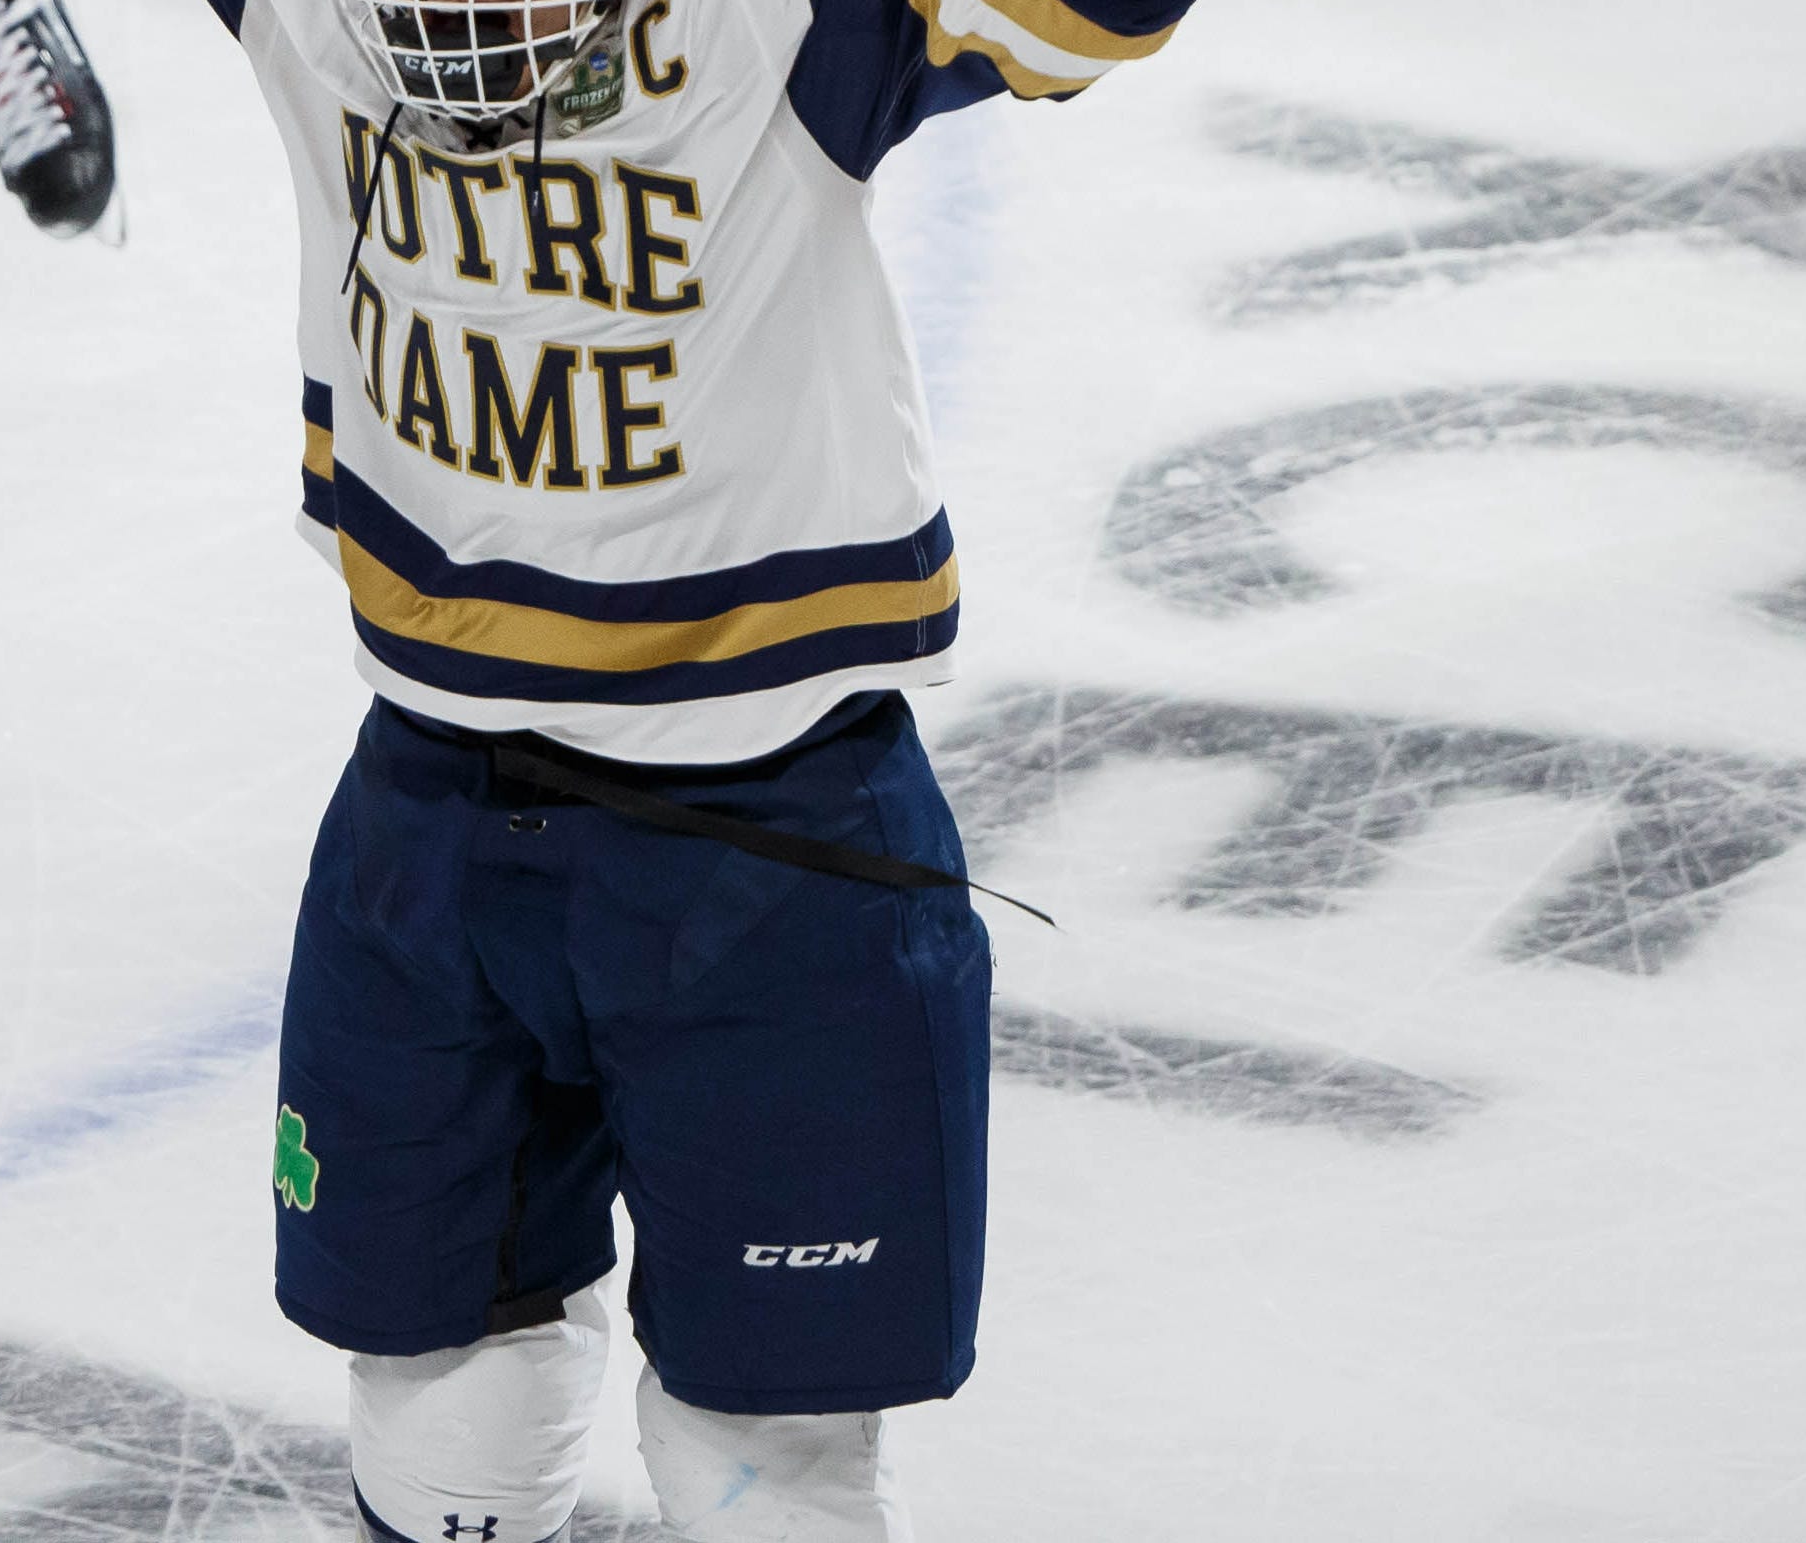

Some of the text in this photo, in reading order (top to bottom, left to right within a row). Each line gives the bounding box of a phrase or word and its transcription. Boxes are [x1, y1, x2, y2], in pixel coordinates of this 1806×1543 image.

[404, 55, 474, 76] CCM
[341, 106, 706, 316] NOTRE
[348, 257, 687, 492] DAME
[742, 1236, 881, 1268] CCM
